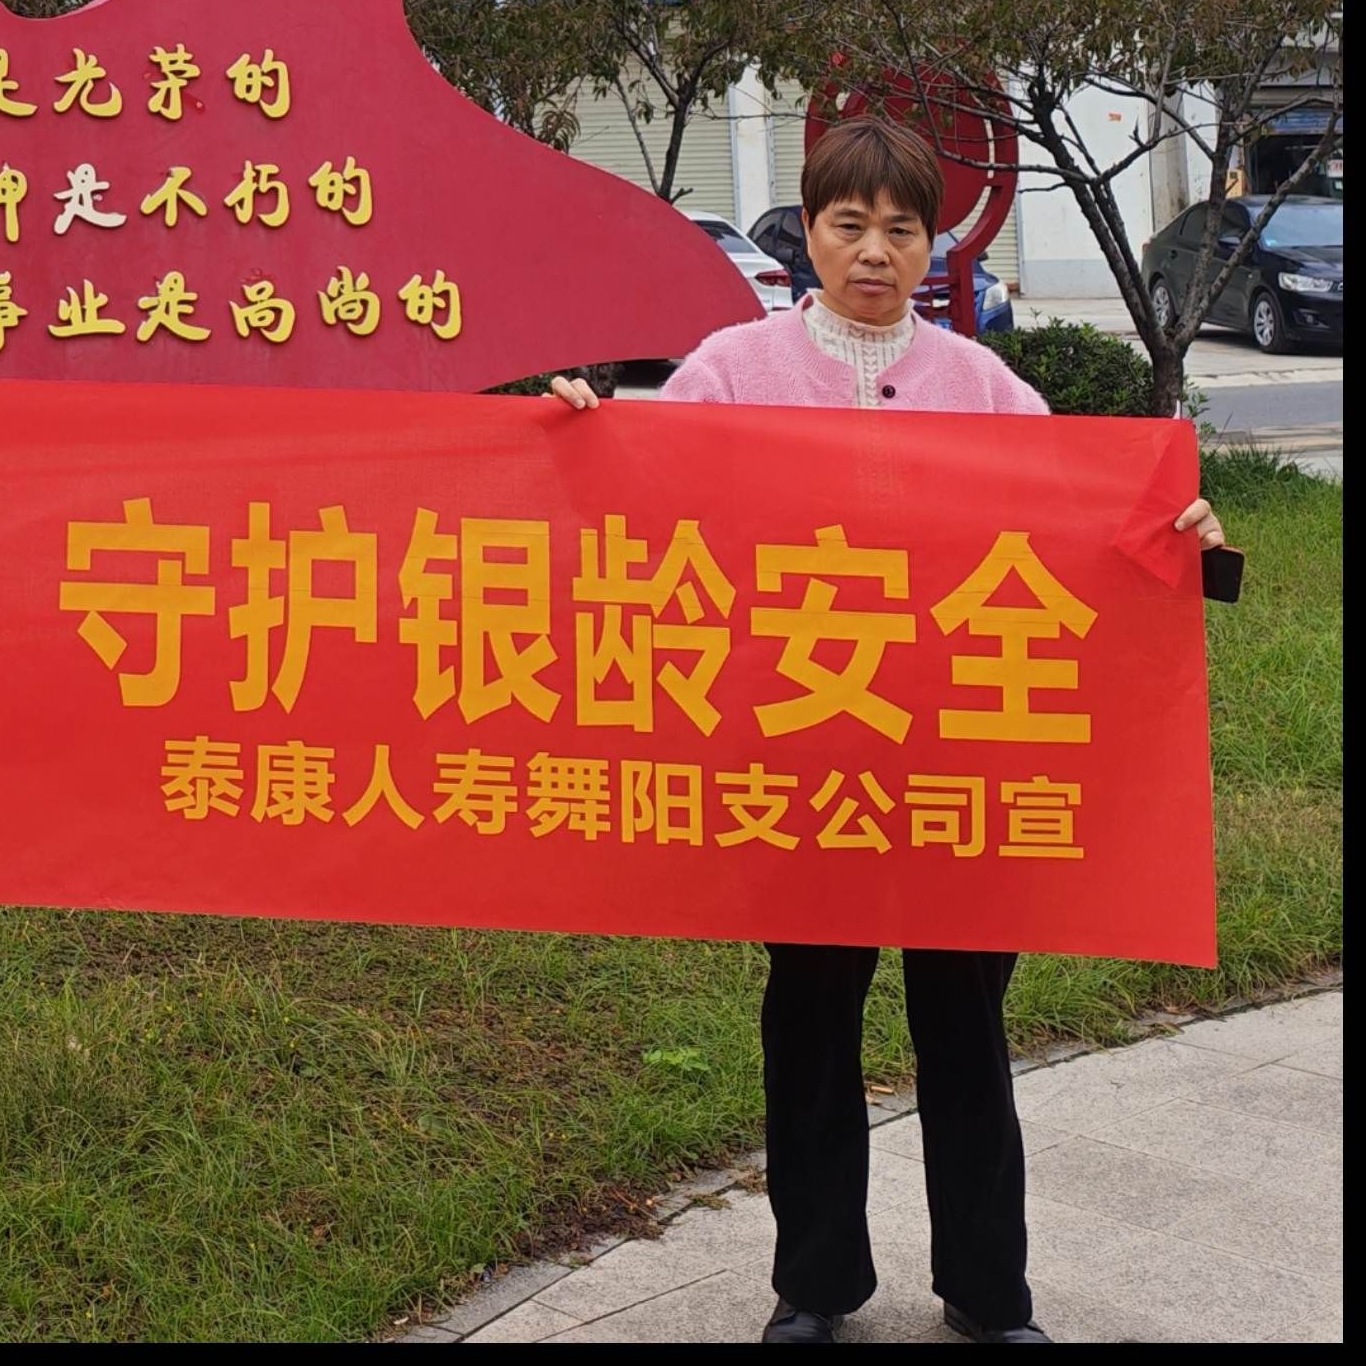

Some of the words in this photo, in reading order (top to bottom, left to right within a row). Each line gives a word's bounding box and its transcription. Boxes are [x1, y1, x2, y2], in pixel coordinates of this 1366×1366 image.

[58, 498, 1099, 745] 守护银龄安全
[160, 736, 1085, 861] 泰康人寿舞阳支公司宣
